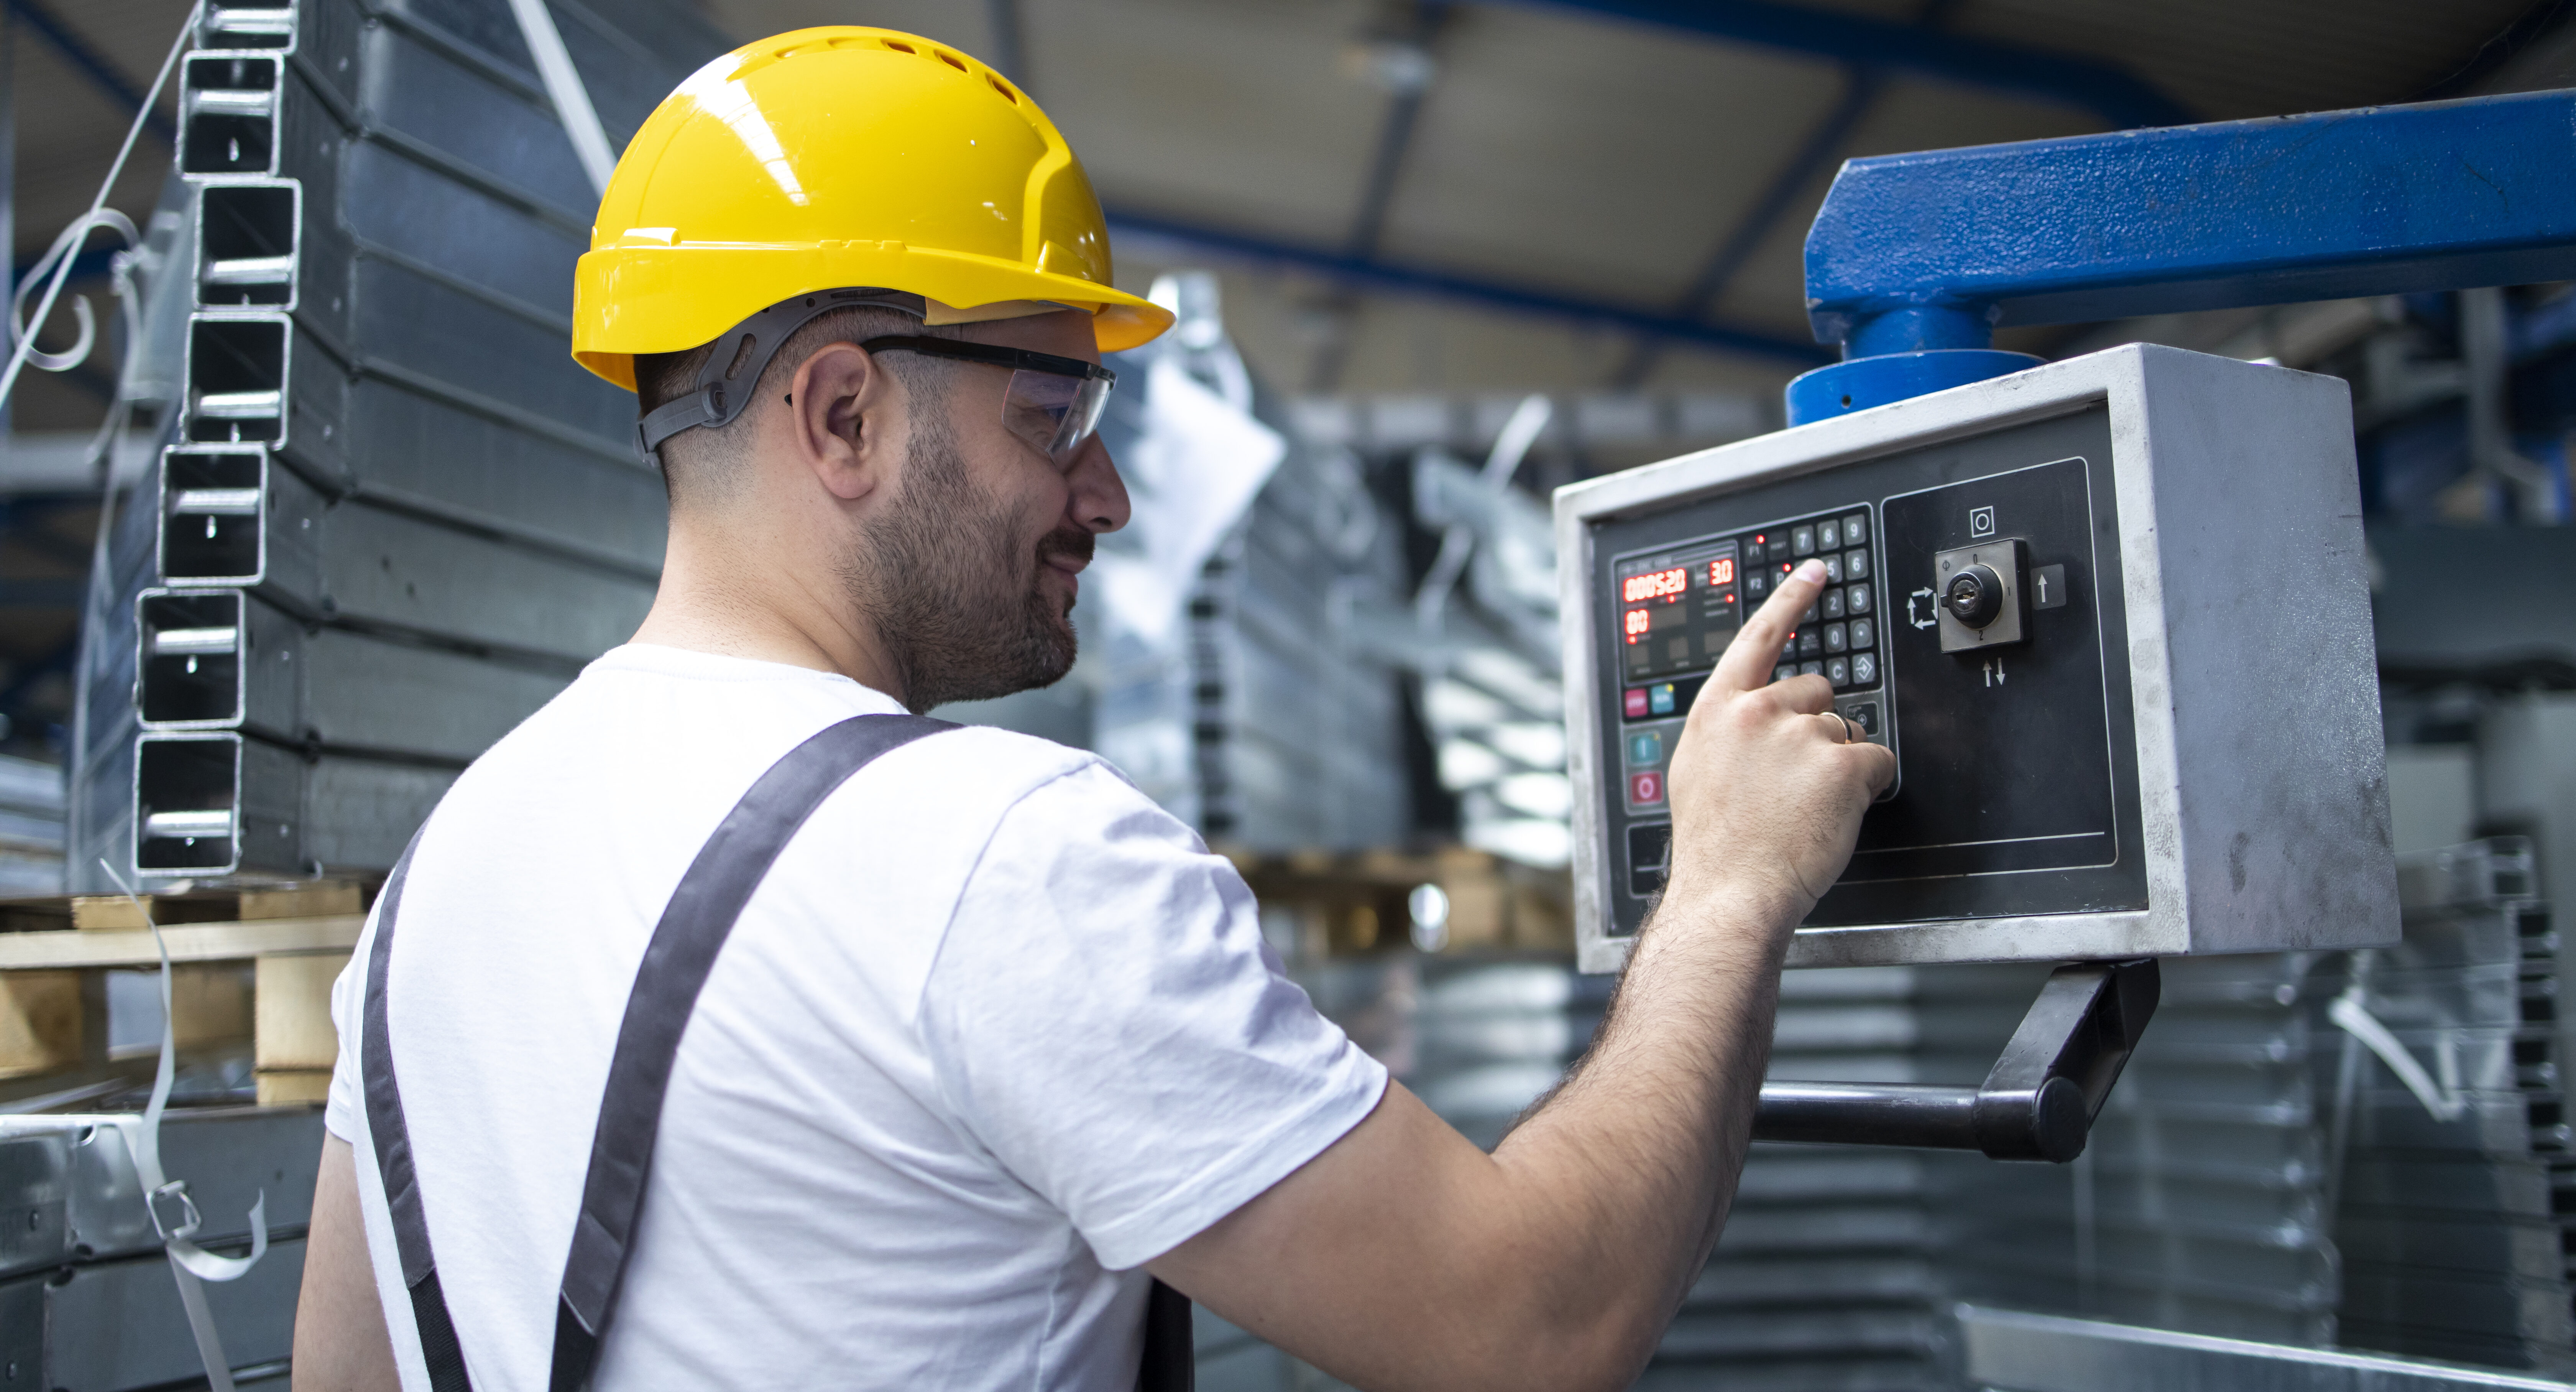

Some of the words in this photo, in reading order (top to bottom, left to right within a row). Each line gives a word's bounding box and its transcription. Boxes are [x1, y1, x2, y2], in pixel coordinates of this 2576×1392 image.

[1825, 528, 1833, 543] 8
[1850, 523, 1858, 537] 9
[1799, 533, 1807, 548] 7
[1853, 557, 1860, 571] 6
[1973, 553, 1978, 564] 0
[1827, 561, 1835, 576] 5
[1750, 578, 1762, 590] F2
[2007, 586, 2011, 596] 1
[1829, 596, 1837, 610] 2
[1855, 591, 1863, 606] 3
[1832, 630, 1839, 645] 0
[1978, 630, 1984, 641] 2
[1832, 665, 1842, 680] C
